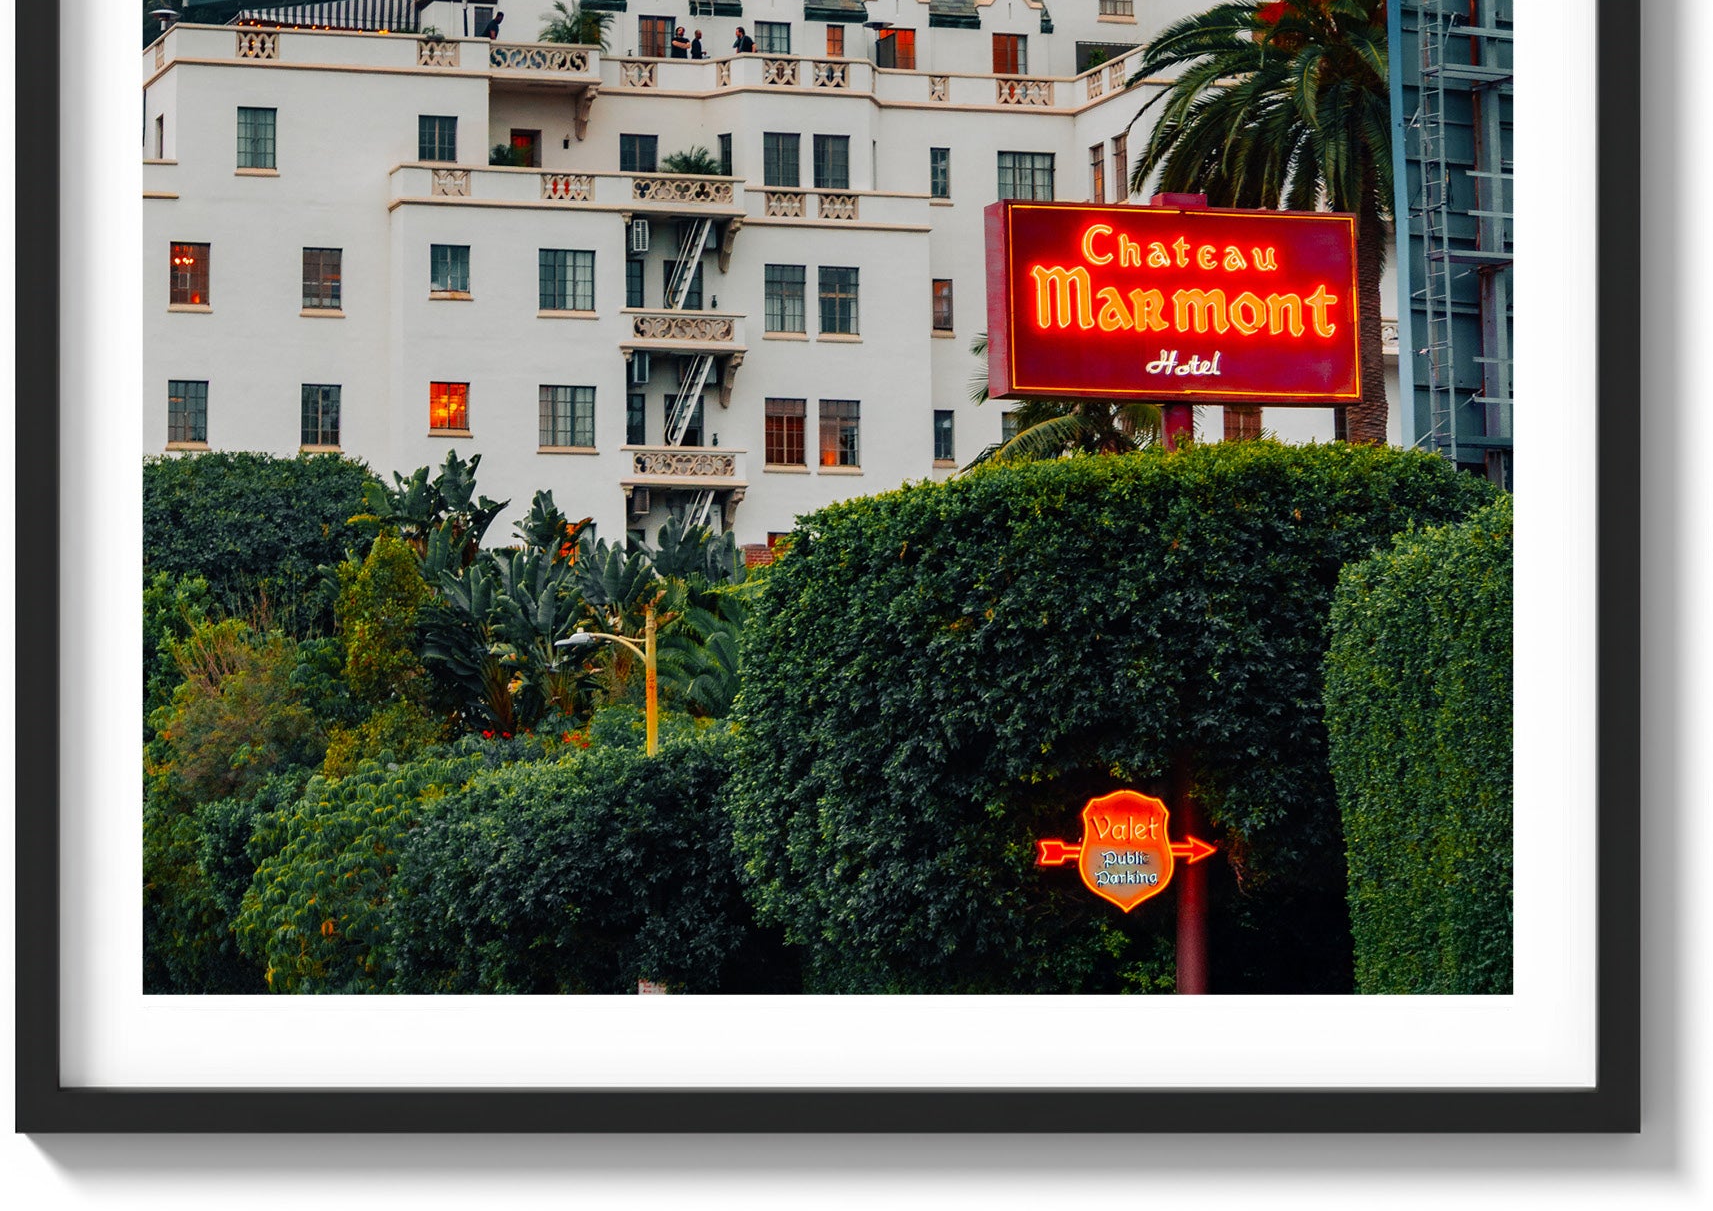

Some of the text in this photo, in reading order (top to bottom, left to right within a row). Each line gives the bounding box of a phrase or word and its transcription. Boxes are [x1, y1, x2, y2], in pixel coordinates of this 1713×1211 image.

[1082, 223, 1277, 271] Chateau
[1031, 265, 1338, 337] Marmont
[1145, 348, 1222, 376] Hotel
[1091, 816, 1159, 840] Valet
[1101, 851, 1149, 867] Public
[1095, 870, 1158, 886] Parking
